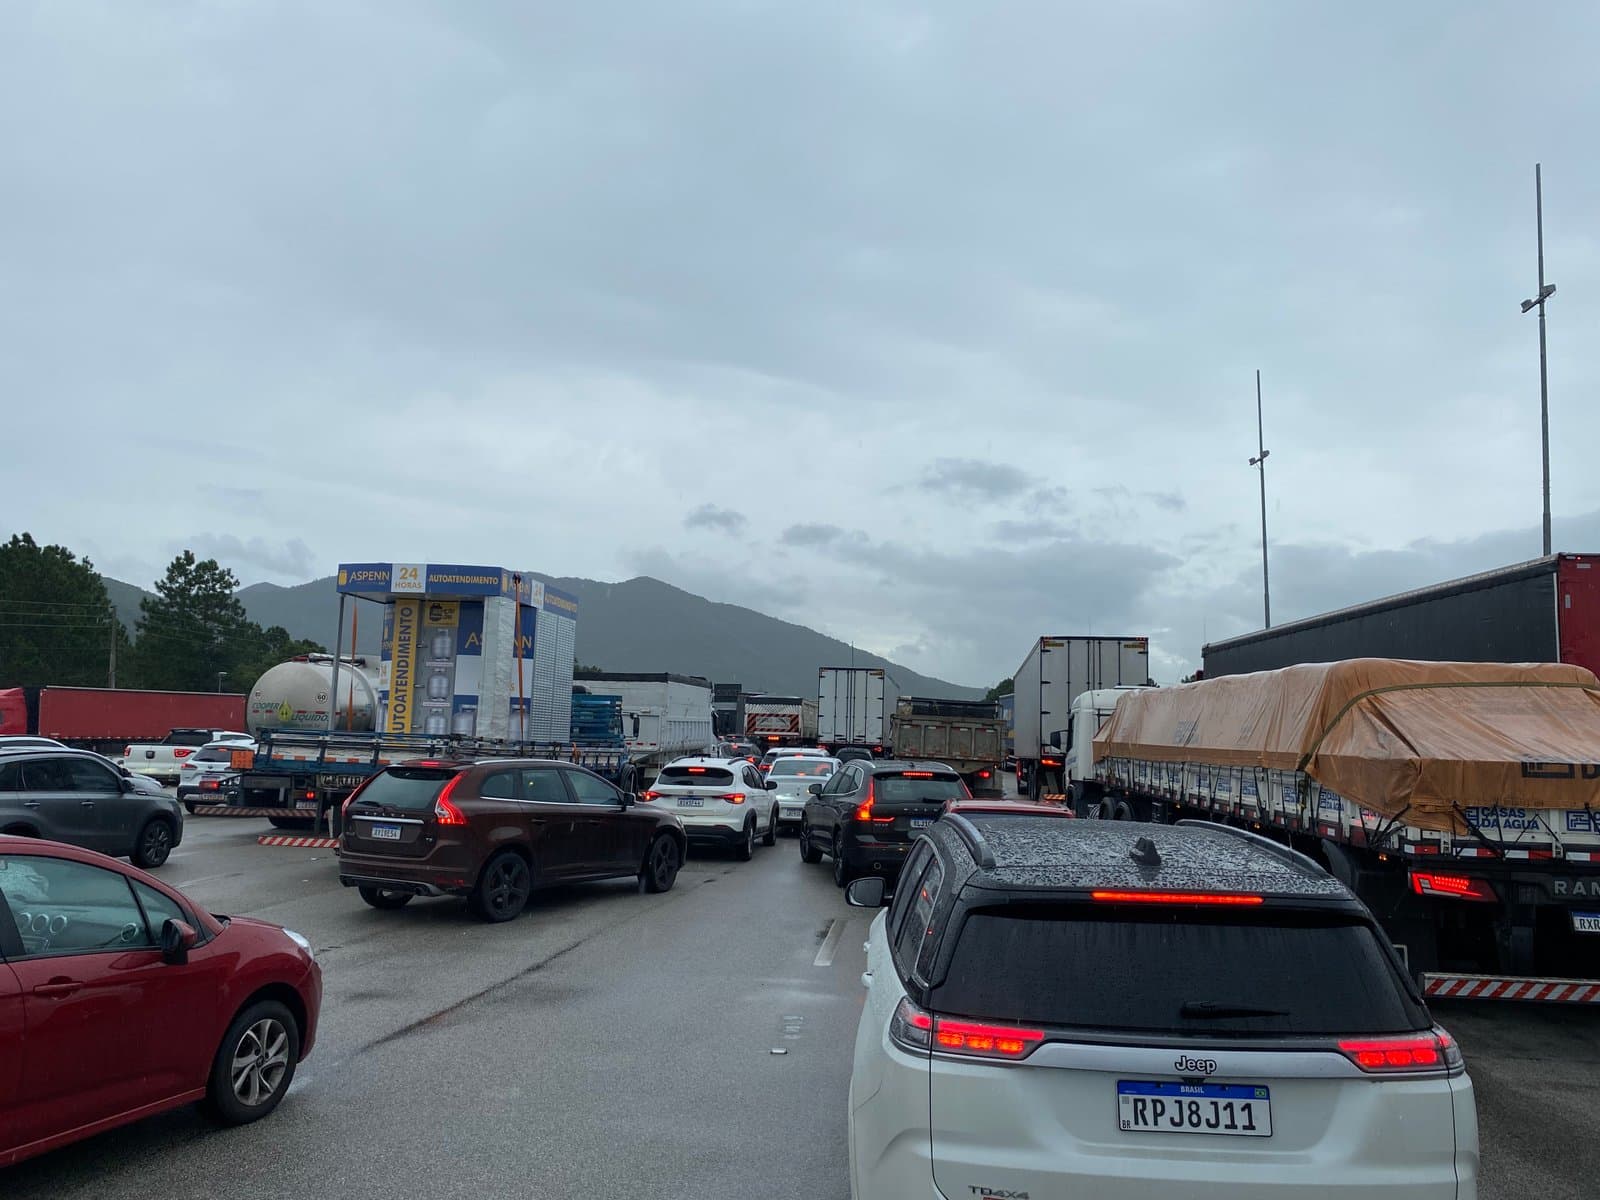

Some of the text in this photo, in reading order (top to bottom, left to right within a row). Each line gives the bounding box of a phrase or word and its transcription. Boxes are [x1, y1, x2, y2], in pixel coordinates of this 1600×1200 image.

[349, 570, 390, 583] ASPENN
[400, 567, 418, 580] 24
[394, 581, 422, 589] HORAS
[428, 574, 499, 585] AUTOATENDIMENTO
[1481, 807, 1526, 818] CASAS
[1482, 819, 1499, 829] DA
[1175, 1055, 1217, 1074] Jeep
[1180, 1085, 1205, 1094] BRASIL
[1133, 1097, 1257, 1131] RPJ8J11
[1122, 1119, 1131, 1129] BR
